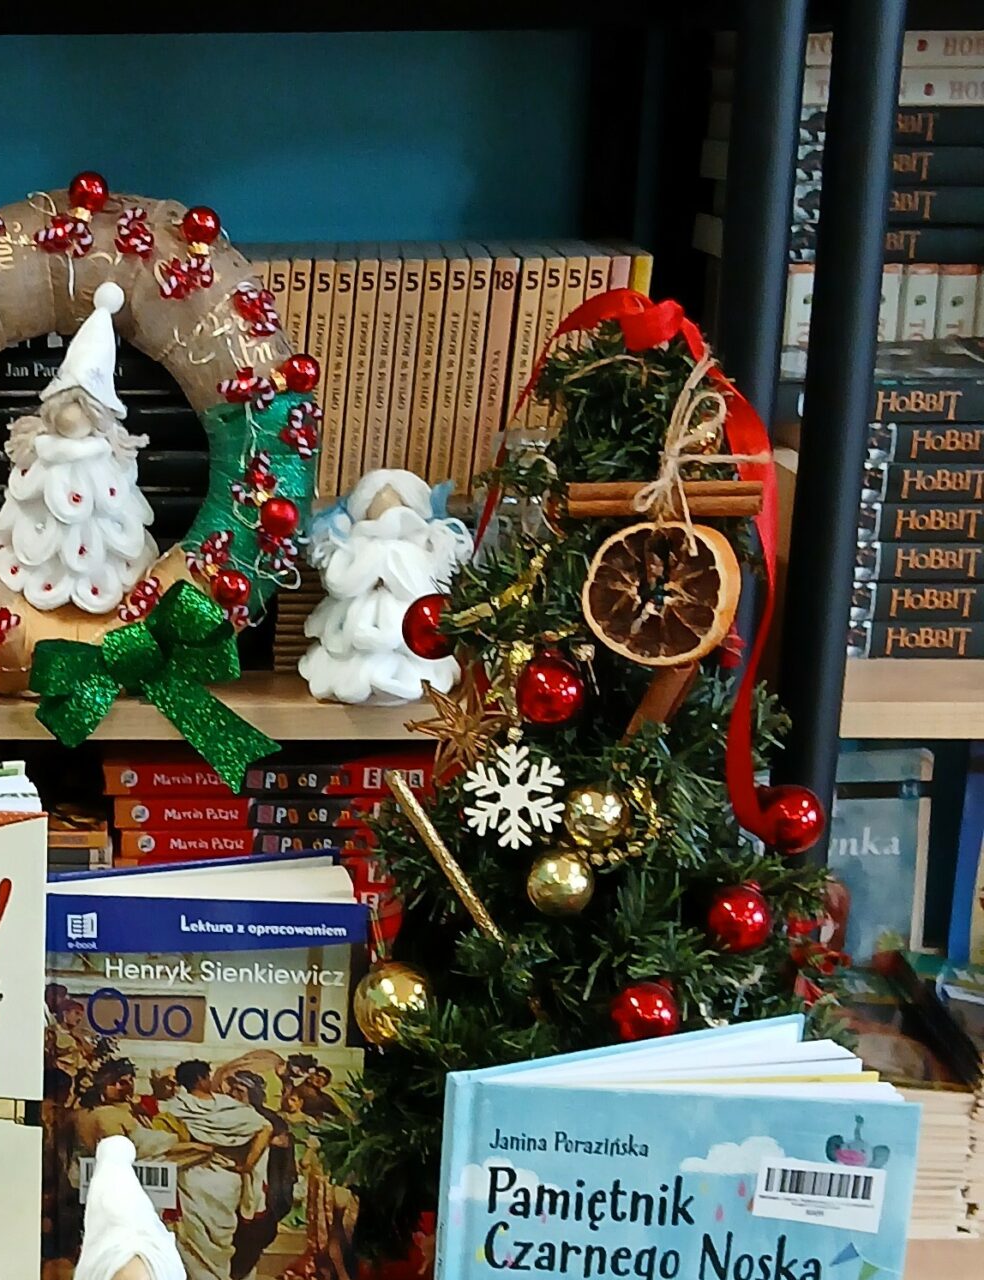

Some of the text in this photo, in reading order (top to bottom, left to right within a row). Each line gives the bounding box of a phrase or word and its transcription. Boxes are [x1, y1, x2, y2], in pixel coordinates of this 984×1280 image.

[273, 273, 286, 292] 5
[293, 271, 306, 291] 5
[317, 273, 331, 293] 5
[338, 273, 351, 293] 5
[361, 271, 374, 291] 5
[383, 271, 397, 291] 5
[405, 271, 419, 292] 5
[429, 271, 442, 291] 5
[452, 270, 465, 291] 5
[473, 270, 486, 290] 5
[494, 270, 514, 291] 18
[525, 270, 539, 290] 5
[547, 268, 561, 288] 5
[567, 268, 581, 288] 5
[589, 268, 604, 288] 5
[5, 363, 29, 377] Jan
[180, 915, 234, 934] Lektura
[248, 923, 347, 938] opracowaniem
[105, 957, 345, 987] Henryk Sienkiewicz
[87, 987, 342, 1044] Quo vadis
[489, 1128, 649, 1158] Janina Porazińska
[486, 1166, 696, 1231] Pamiętnik
